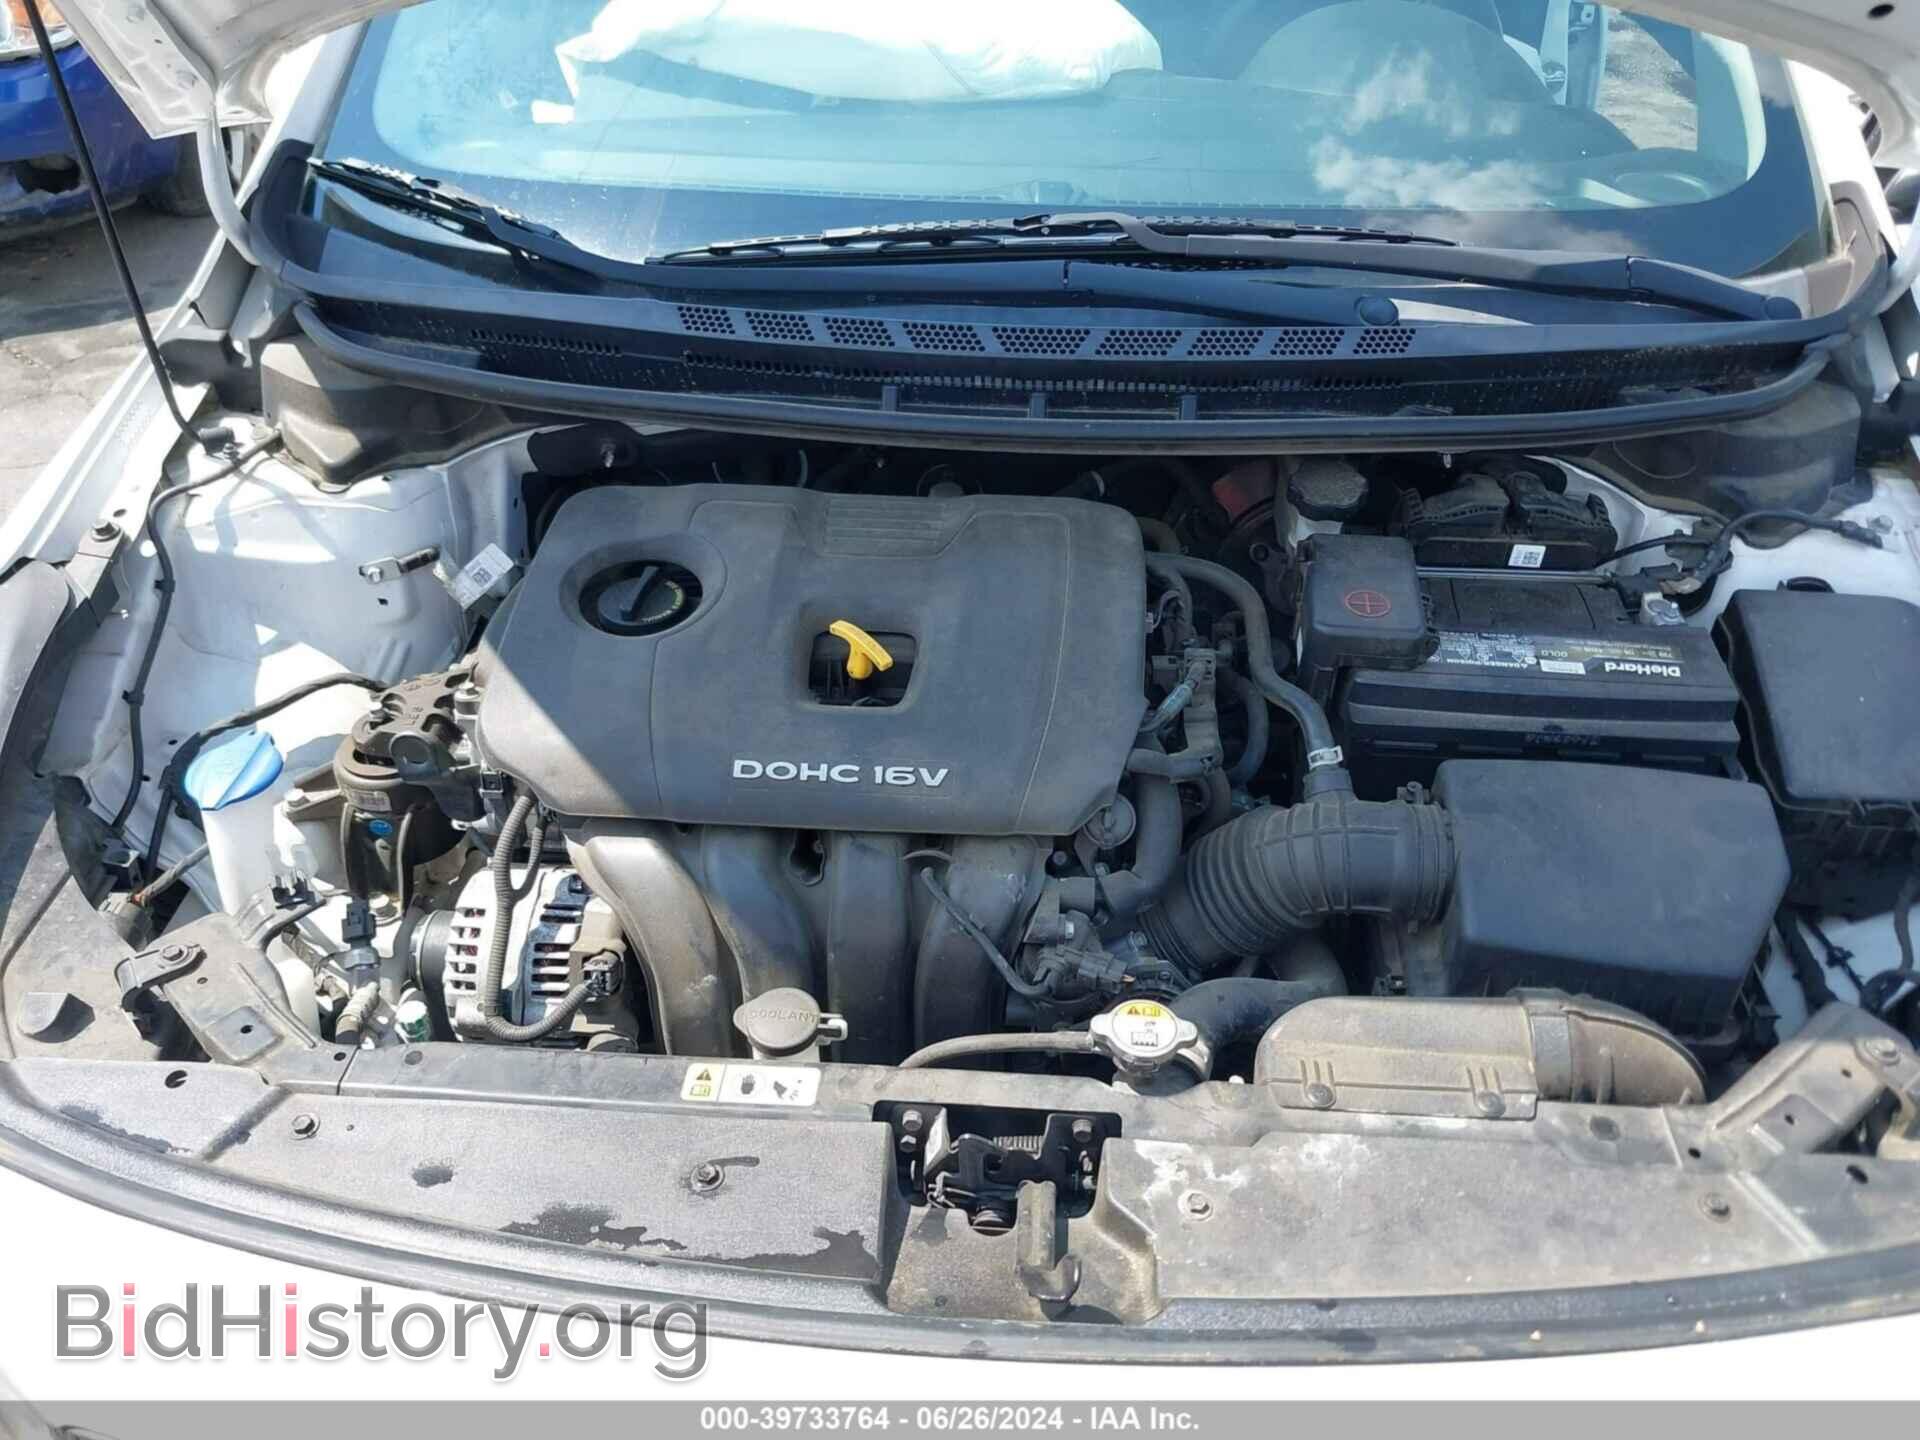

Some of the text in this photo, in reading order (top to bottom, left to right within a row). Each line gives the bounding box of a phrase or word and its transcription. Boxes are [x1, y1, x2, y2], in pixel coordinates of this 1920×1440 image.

[1604, 661, 1682, 677] DieHard
[732, 759, 949, 787] DOHC 16V
[749, 1007, 818, 1024] COOLANT
